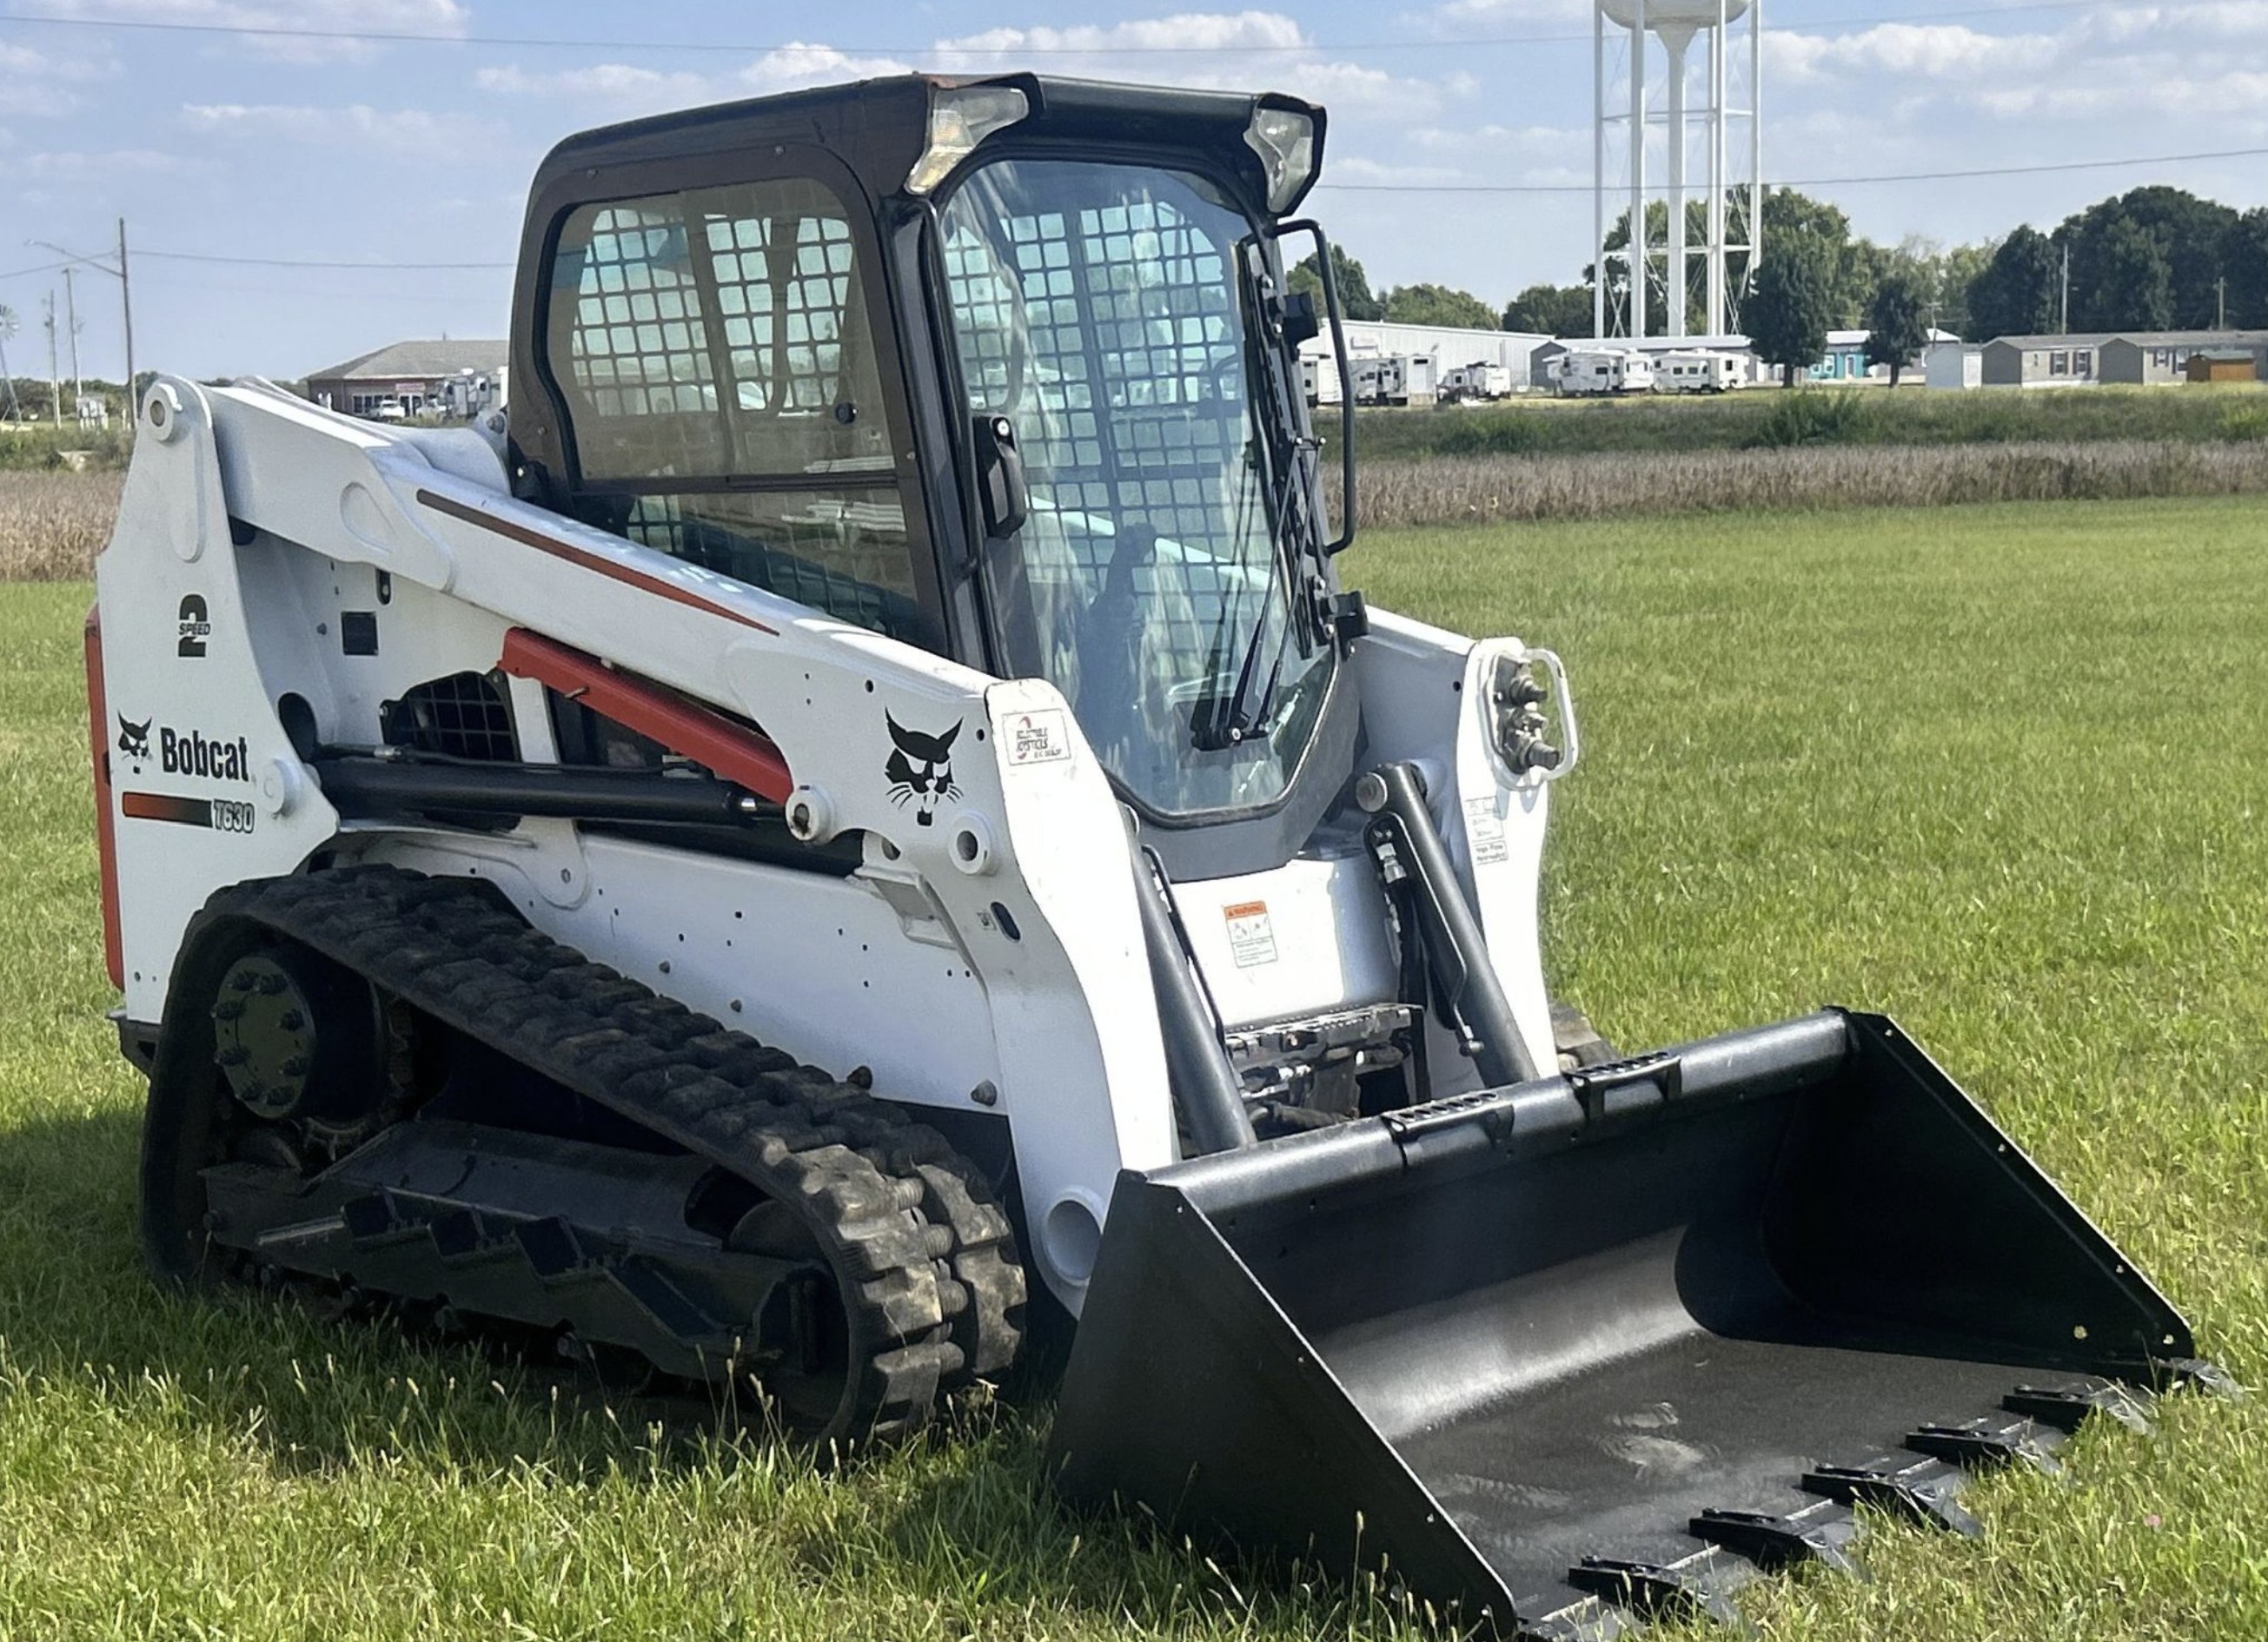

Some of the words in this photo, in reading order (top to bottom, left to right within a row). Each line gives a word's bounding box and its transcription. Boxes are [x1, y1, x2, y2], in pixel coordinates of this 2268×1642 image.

[178, 593, 208, 658] 2
[178, 622, 210, 635] SPEED
[160, 726, 249, 783] Bobcat
[213, 798, 255, 834] T630
